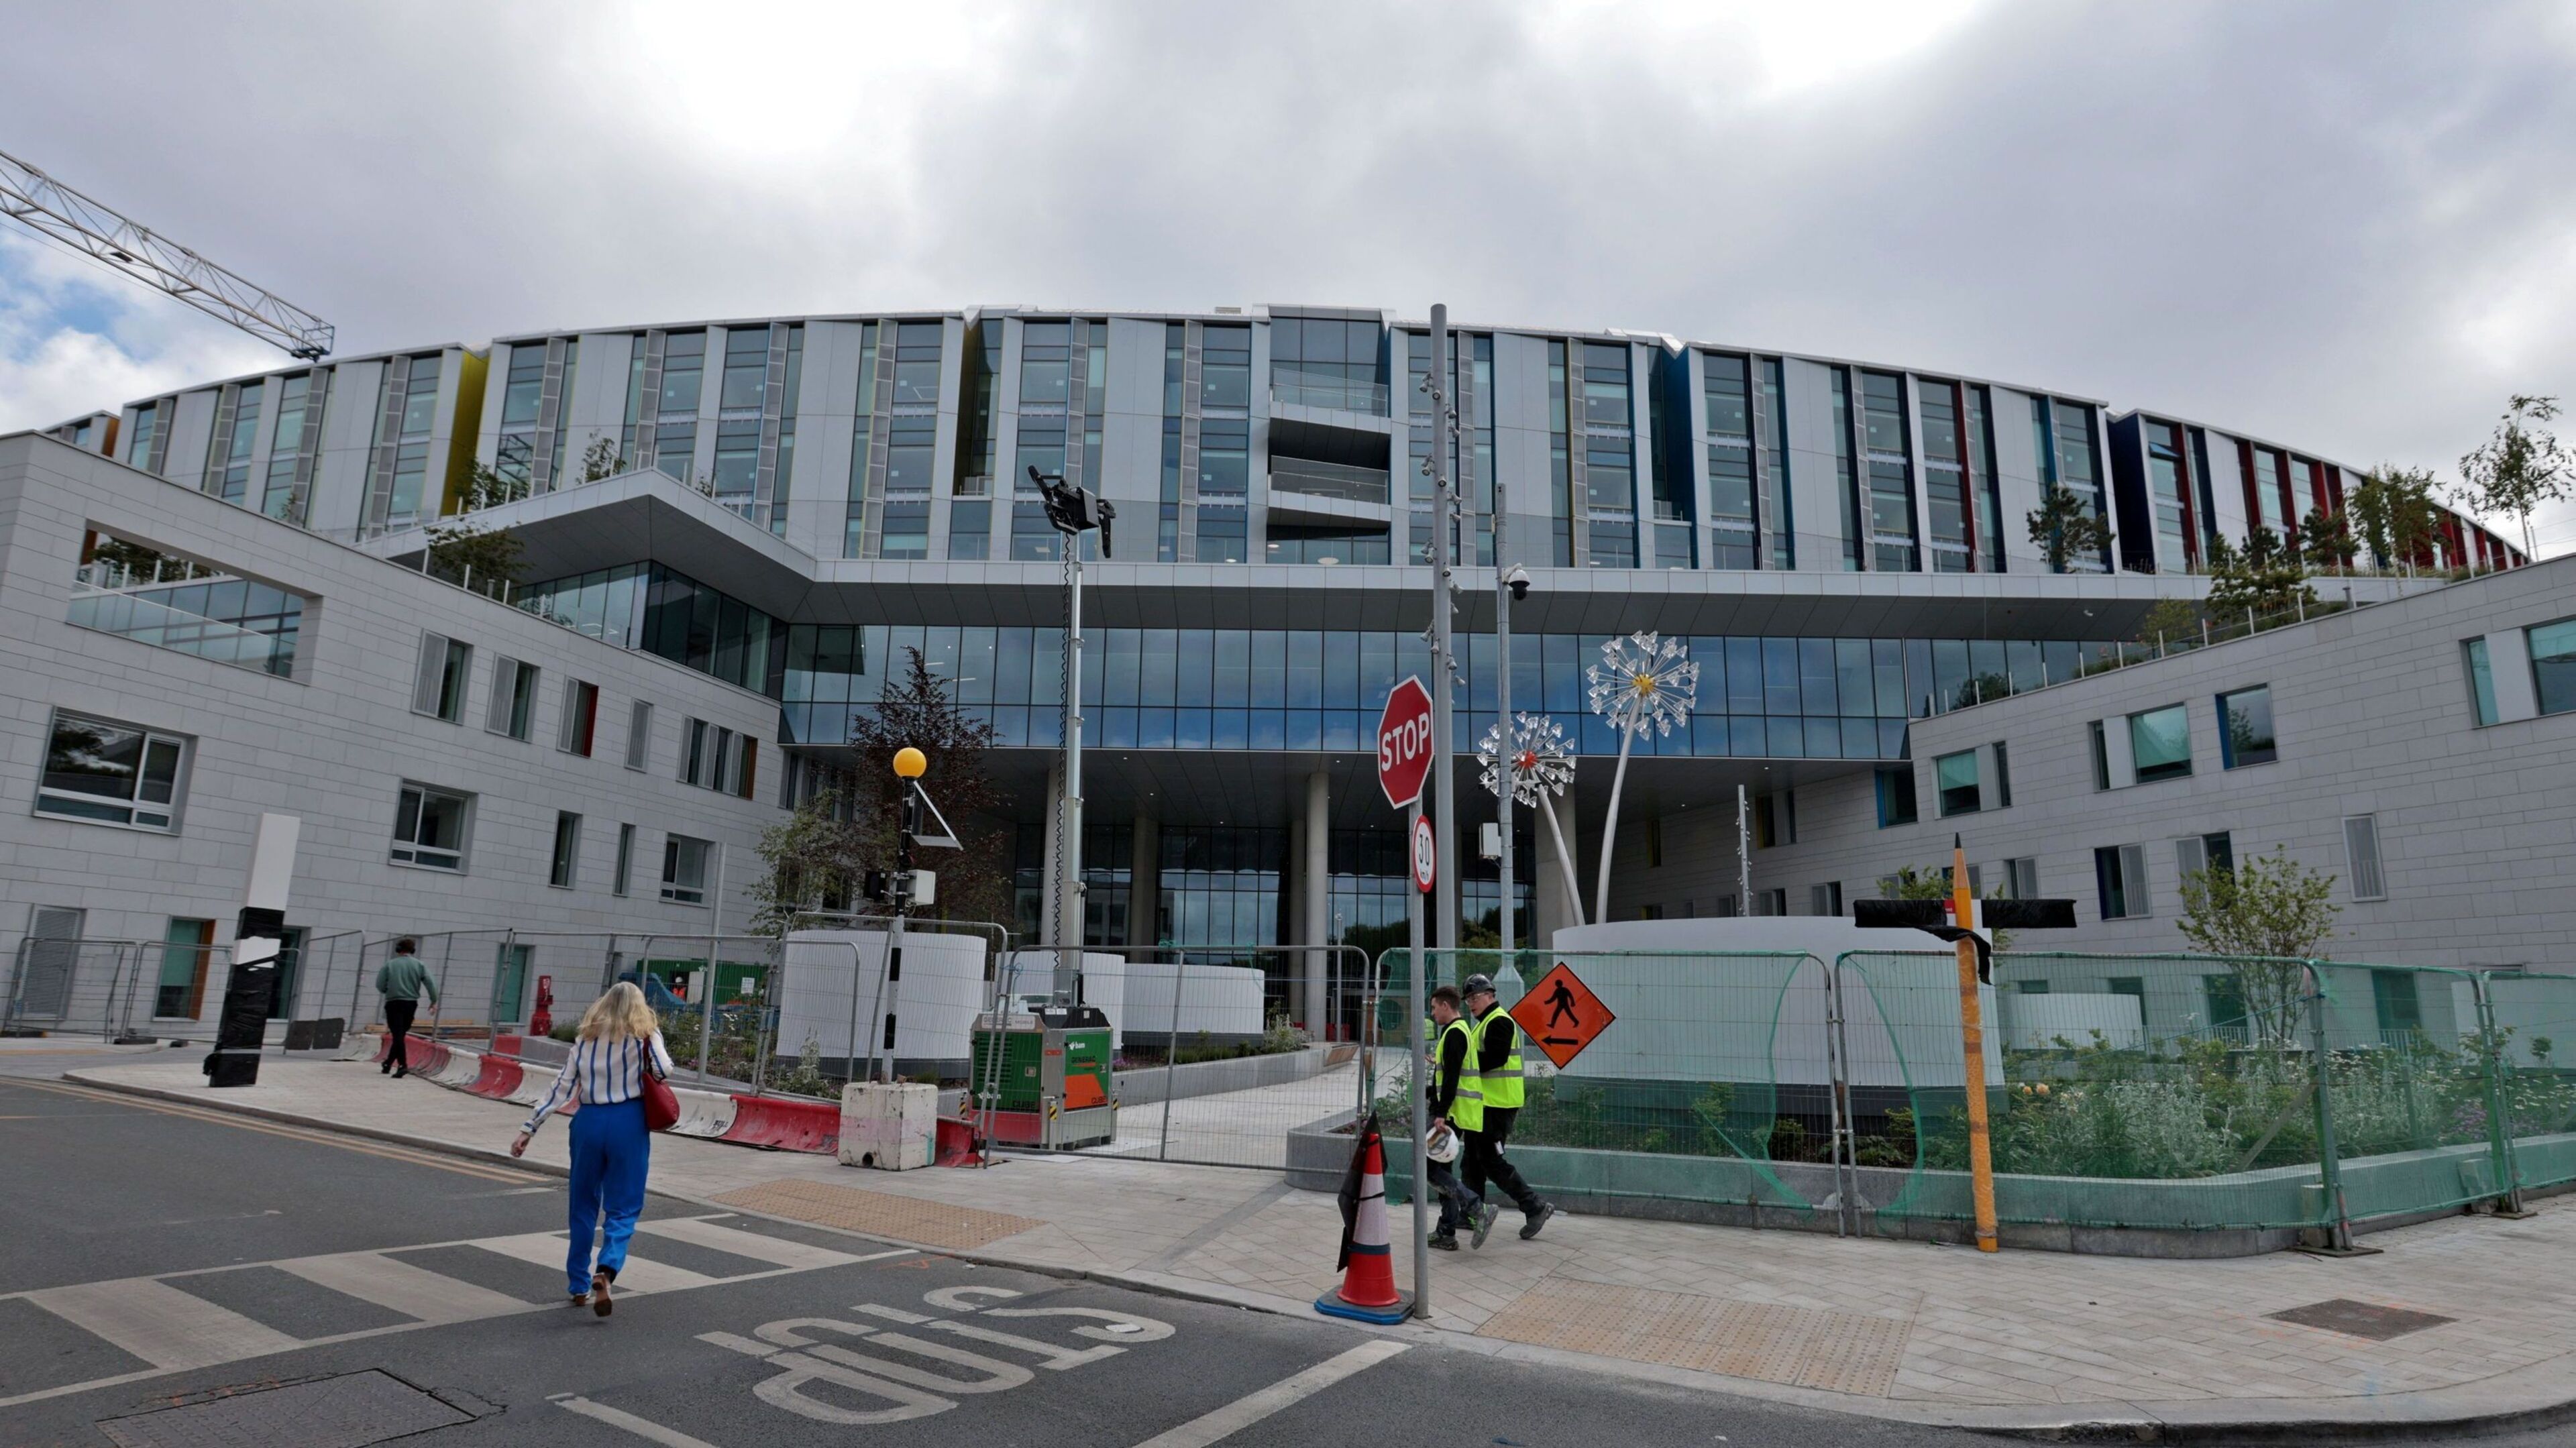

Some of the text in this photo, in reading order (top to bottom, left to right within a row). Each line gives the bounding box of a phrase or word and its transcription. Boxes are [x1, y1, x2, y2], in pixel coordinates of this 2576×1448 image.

[1382, 712, 1429, 771] STOP
[1419, 834, 1430, 866] 30
[693, 1286, 1176, 1424] STOP
